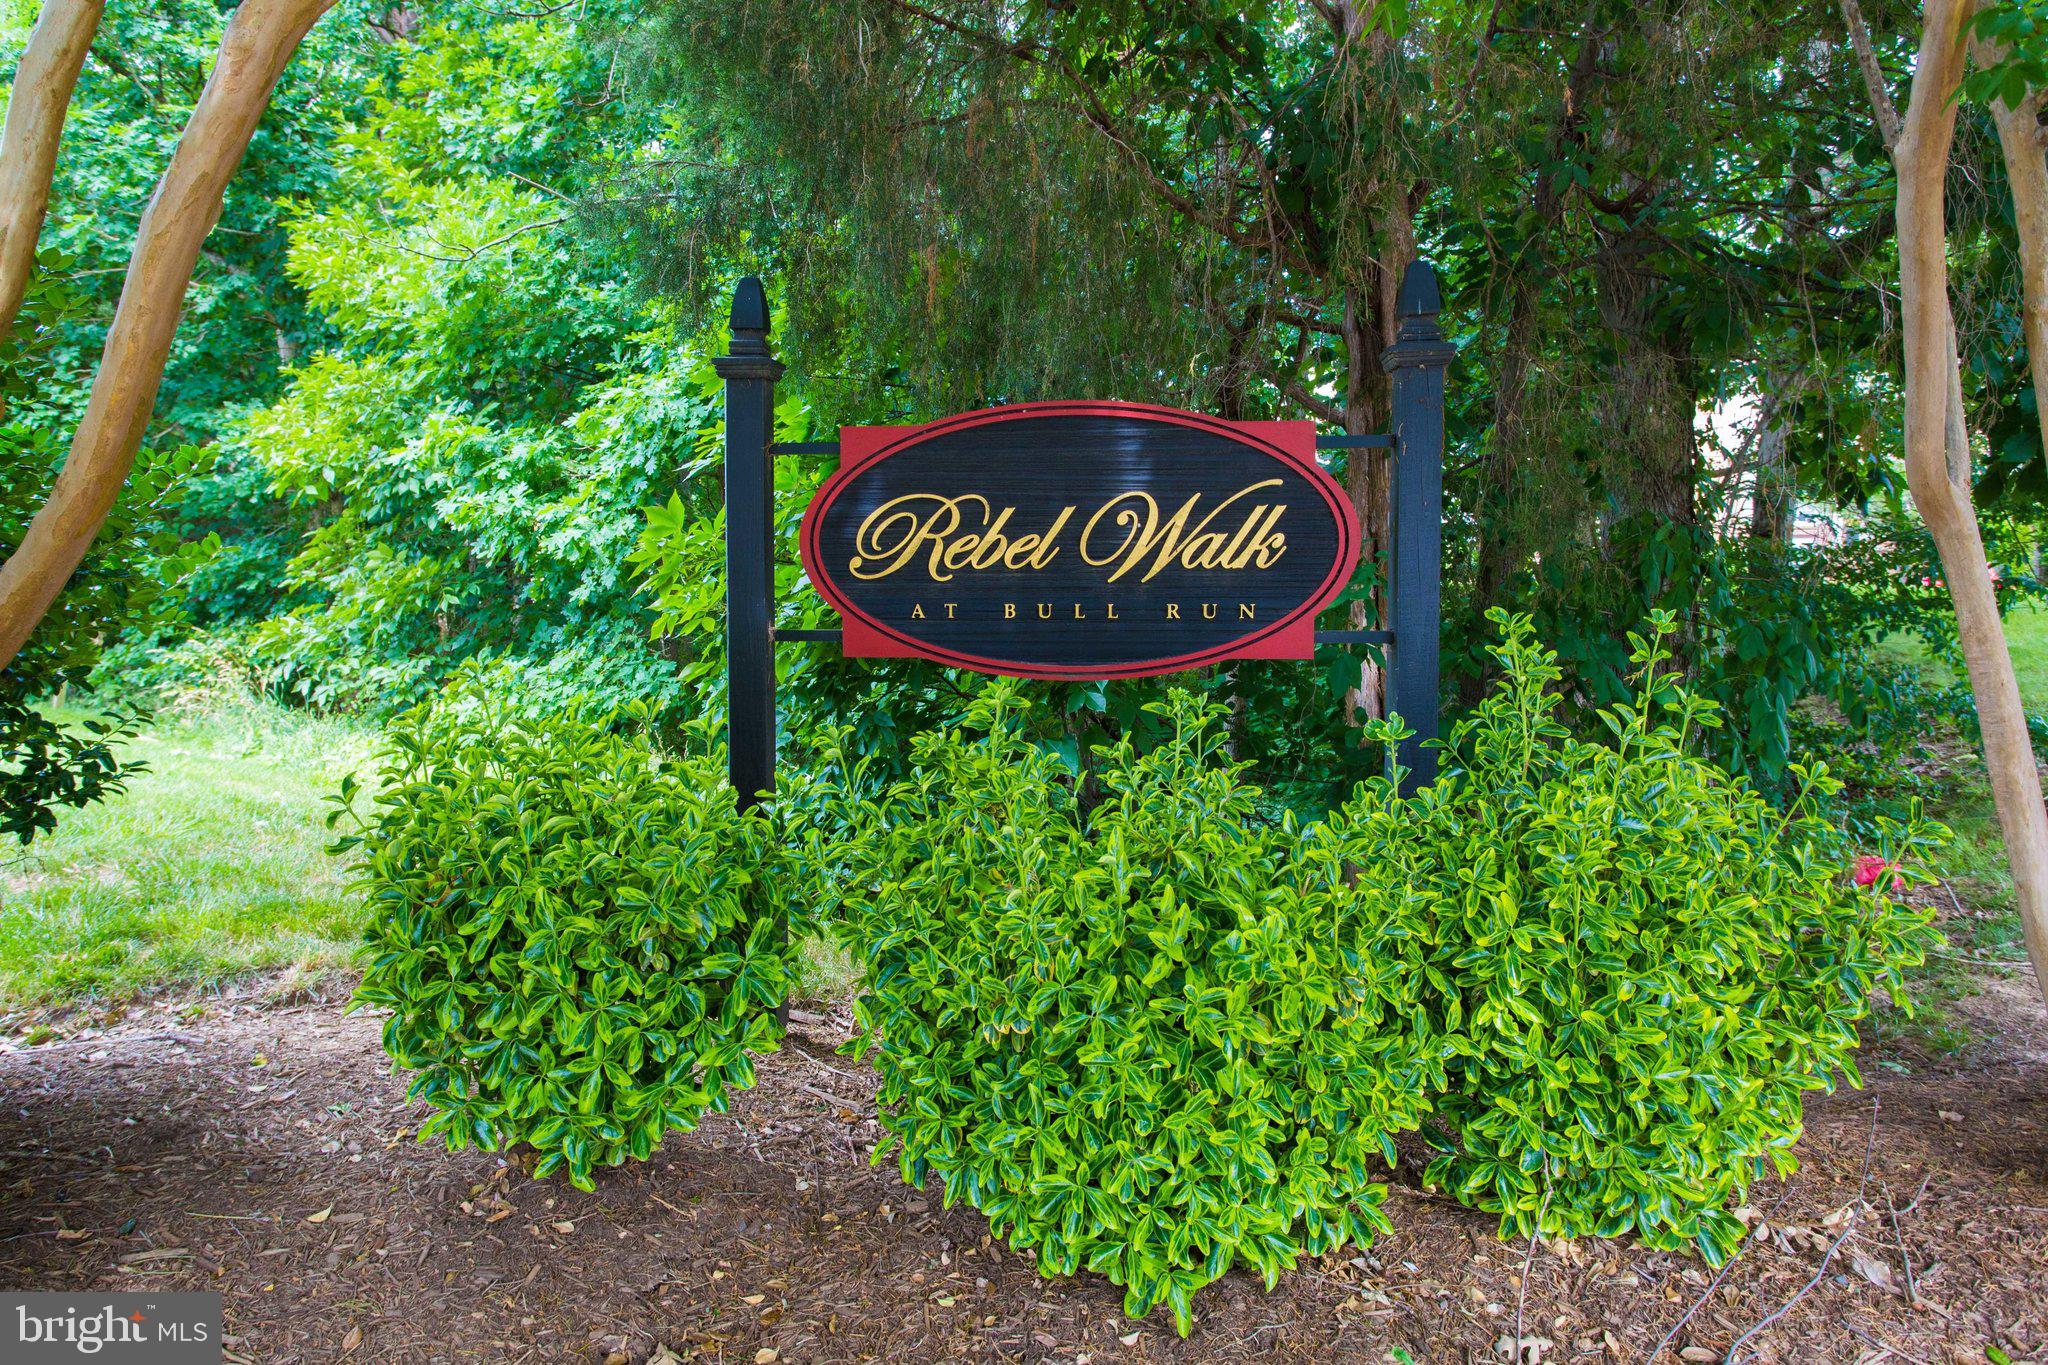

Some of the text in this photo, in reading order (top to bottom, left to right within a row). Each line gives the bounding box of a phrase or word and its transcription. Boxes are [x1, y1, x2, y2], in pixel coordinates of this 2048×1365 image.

[849, 478, 1288, 584] Rebel Walk
[911, 603, 1257, 619] AT BULL RUN
